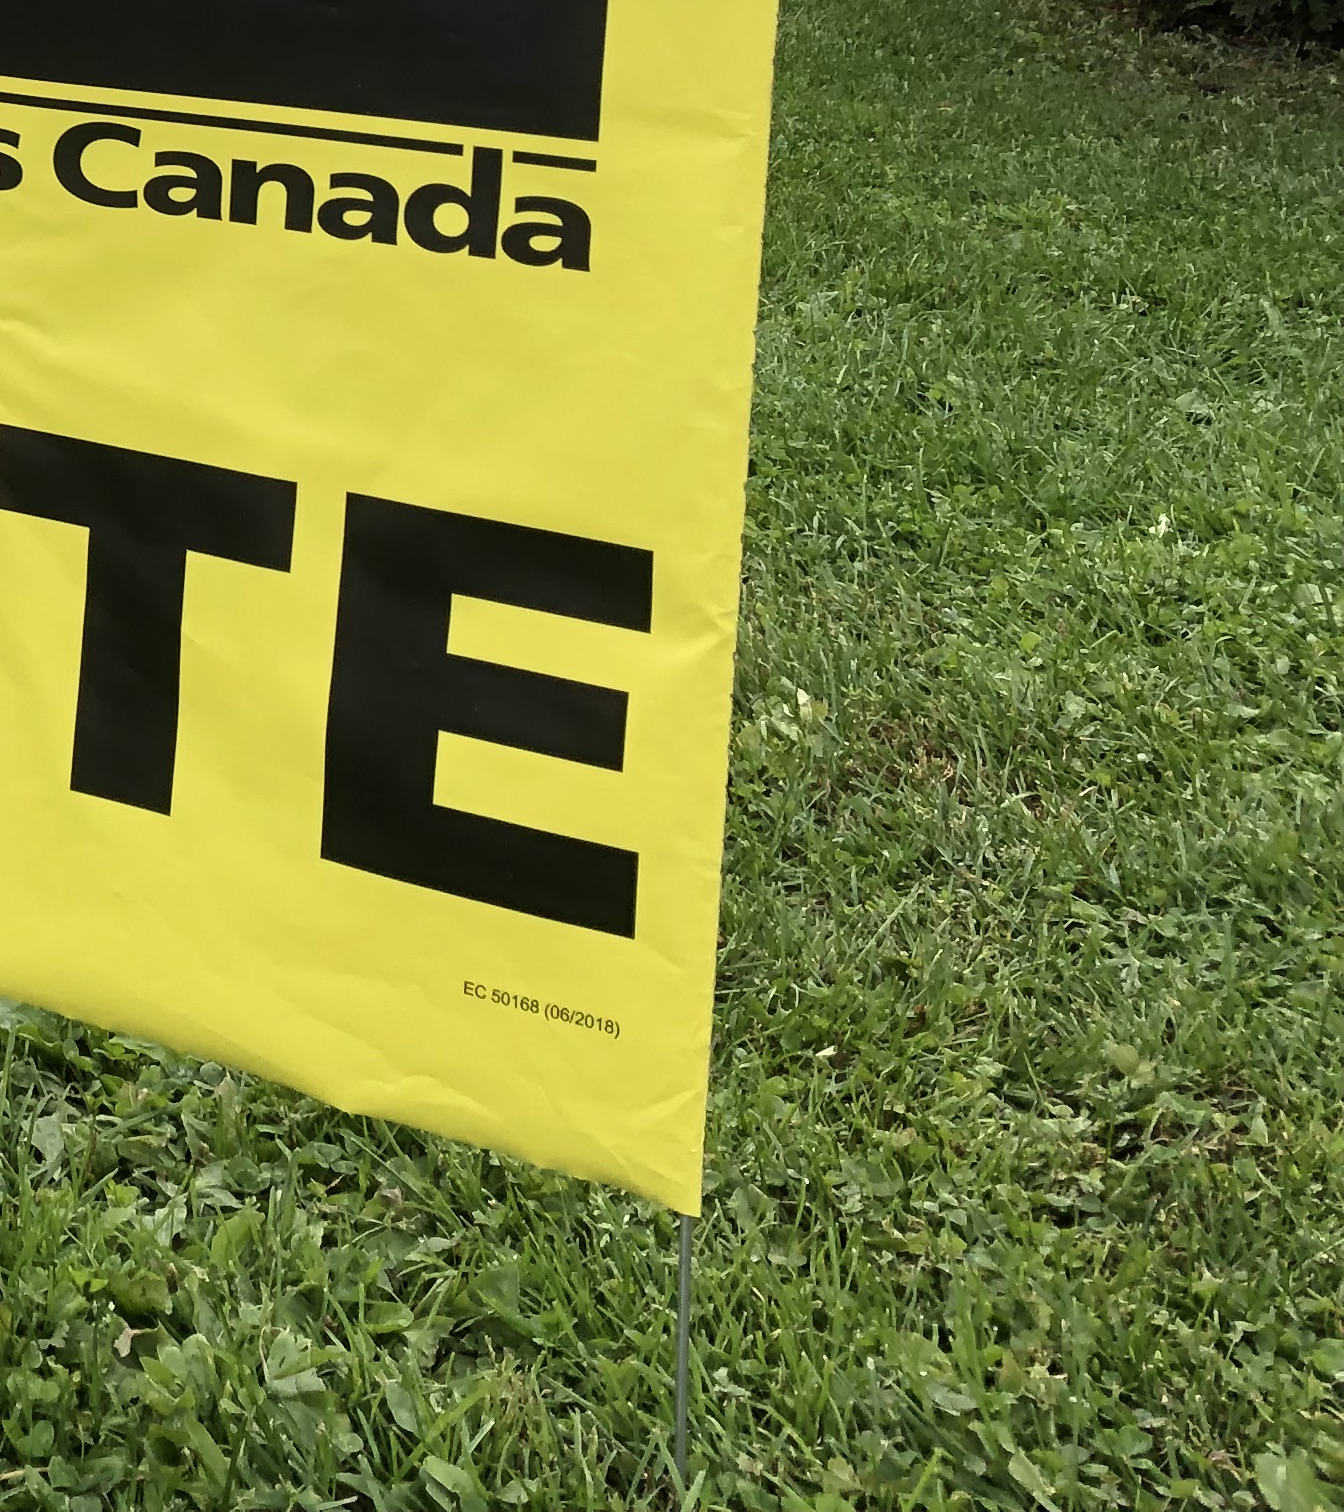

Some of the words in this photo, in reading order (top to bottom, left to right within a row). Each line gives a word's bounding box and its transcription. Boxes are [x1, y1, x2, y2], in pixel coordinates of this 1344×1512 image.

[53, 121, 593, 272] Canada
[463, 980, 487, 1000] EC
[491, 988, 540, 1014] 50168
[544, 1003, 621, 1040] (06/2018)
